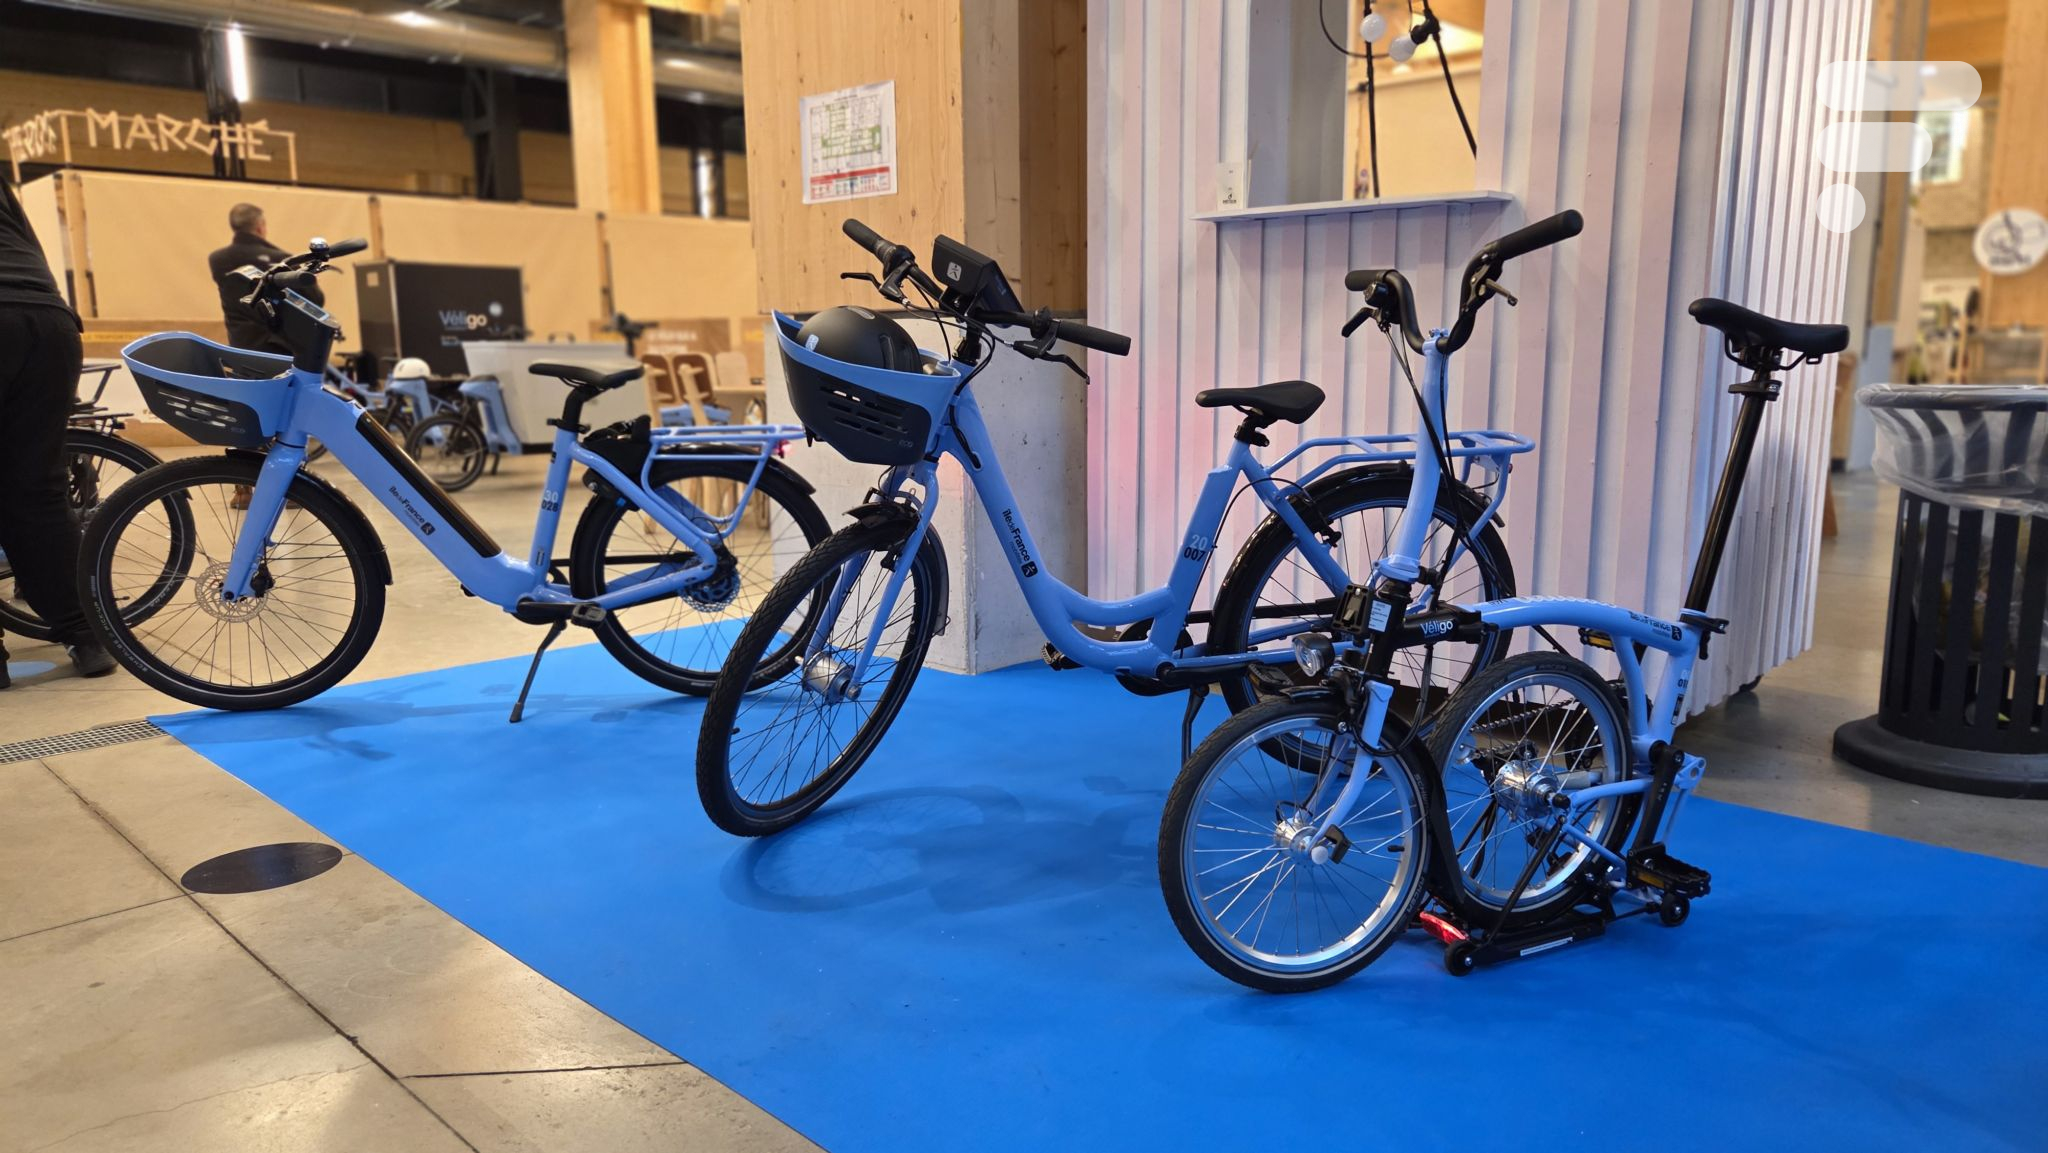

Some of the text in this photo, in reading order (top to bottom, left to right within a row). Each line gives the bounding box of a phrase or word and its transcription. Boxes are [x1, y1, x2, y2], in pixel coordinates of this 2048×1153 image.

[86, 108, 271, 161] MARCHÉ
[544, 490, 559, 502] 30
[1190, 534, 1208, 550] 20
[1184, 546, 1206, 562] 007
[1420, 620, 1453, 635] Véligo
